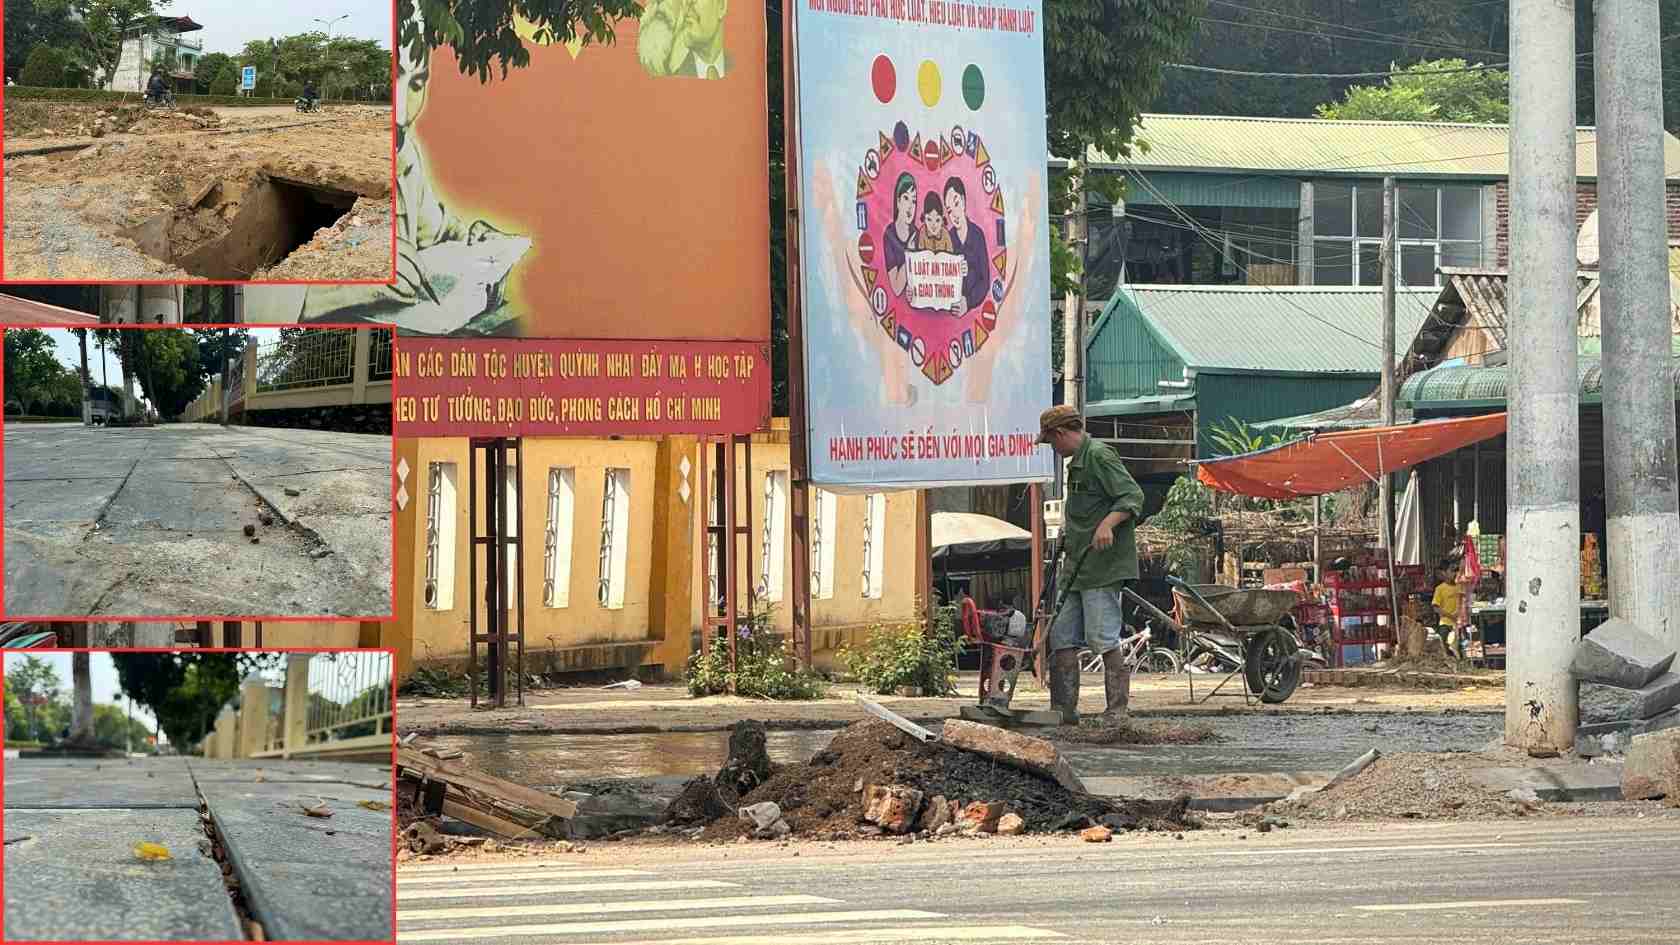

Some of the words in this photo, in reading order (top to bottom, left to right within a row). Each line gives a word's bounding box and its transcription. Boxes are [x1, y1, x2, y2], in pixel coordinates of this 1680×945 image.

[418, 347, 444, 377] CÁC
[451, 347, 477, 377] DÂN
[483, 348, 507, 384] TỘC
[513, 349, 553, 384] HUYỆN
[559, 346, 600, 380] QUỲNH
[606, 353, 634, 377] NHAI
[708, 355, 730, 384] HỌC
[422, 394, 440, 422] TƯ
[667, 392, 685, 420] CHÍ
[691, 397, 721, 421] MINH
[830, 436, 863, 469] HẠNH
[867, 430, 897, 461] PHÚC
[918, 426, 940, 459] ĐẾN
[943, 428, 961, 459] VỚI
[965, 434, 984, 466] MỌI
[988, 433, 1006, 457] GIA
